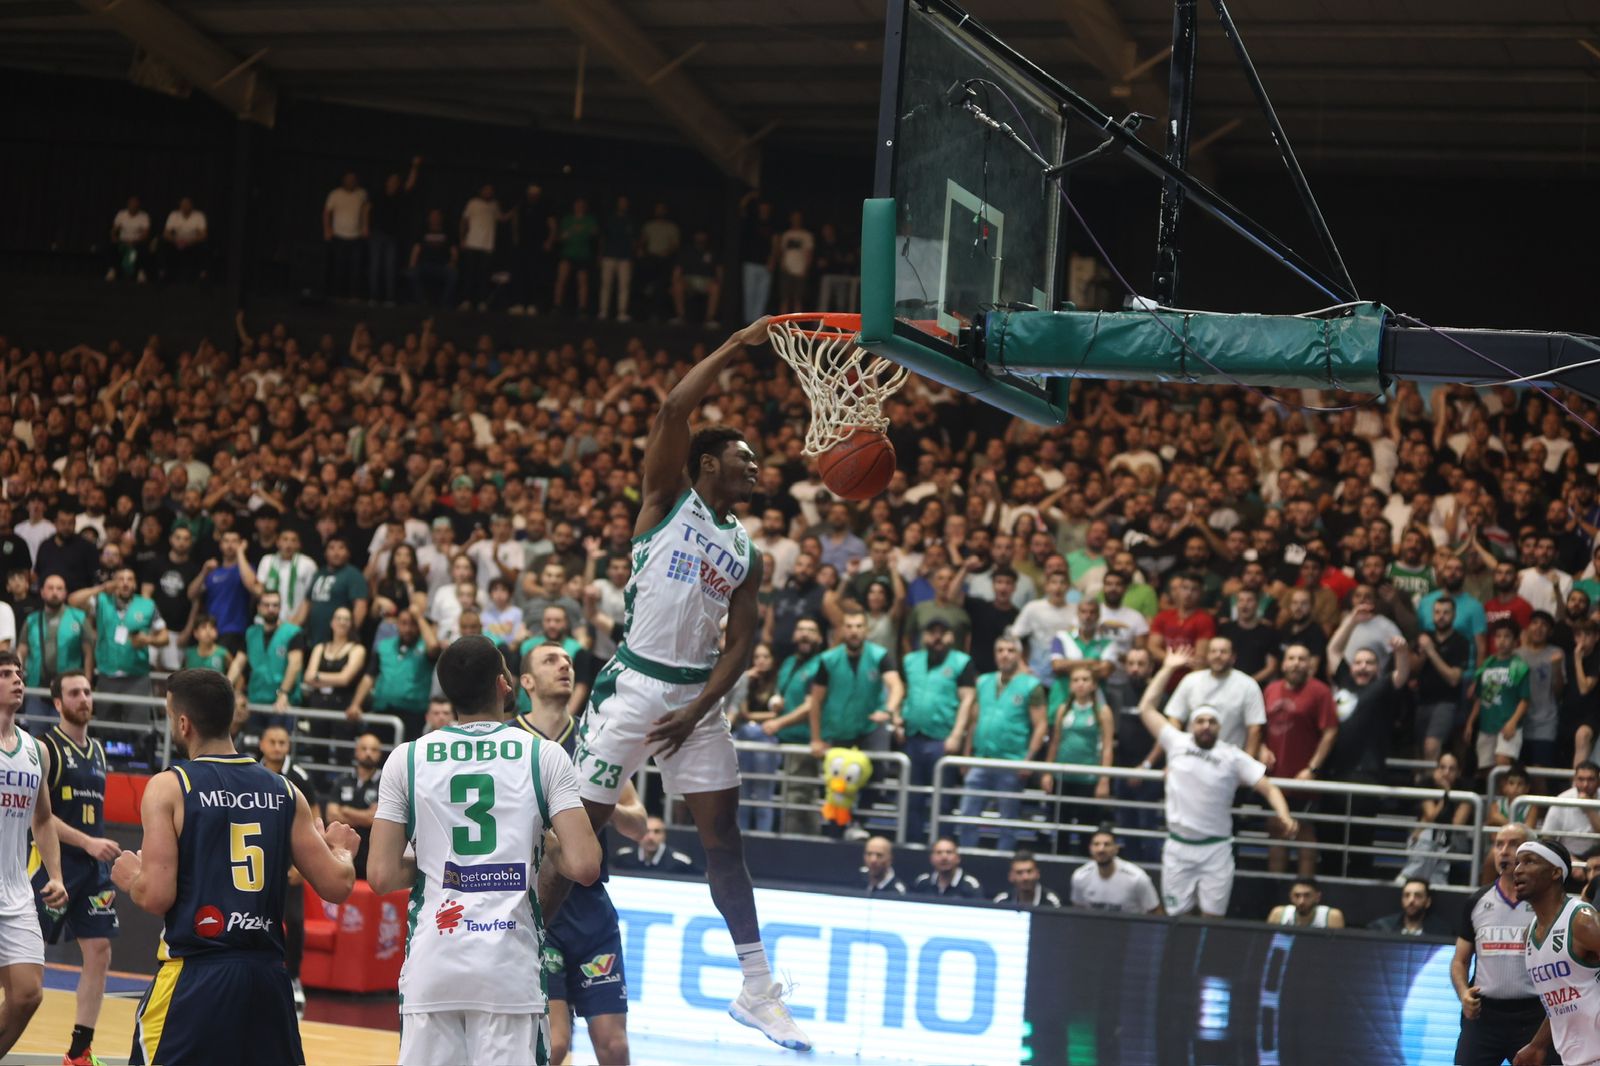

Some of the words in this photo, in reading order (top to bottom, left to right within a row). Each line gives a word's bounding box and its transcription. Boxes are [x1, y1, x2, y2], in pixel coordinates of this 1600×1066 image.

[682, 522, 744, 581] TECNO
[426, 740, 523, 762] BOBO
[589, 759, 623, 789] 23
[199, 789, 285, 811] MEDGULF
[450, 774, 497, 856] 3
[230, 822, 265, 892] 5
[461, 867, 521, 883] betarabia
[617, 908, 998, 1036] TECNO
[1544, 986, 1581, 1007] BMA
[1553, 1003, 1578, 1016] Paints
